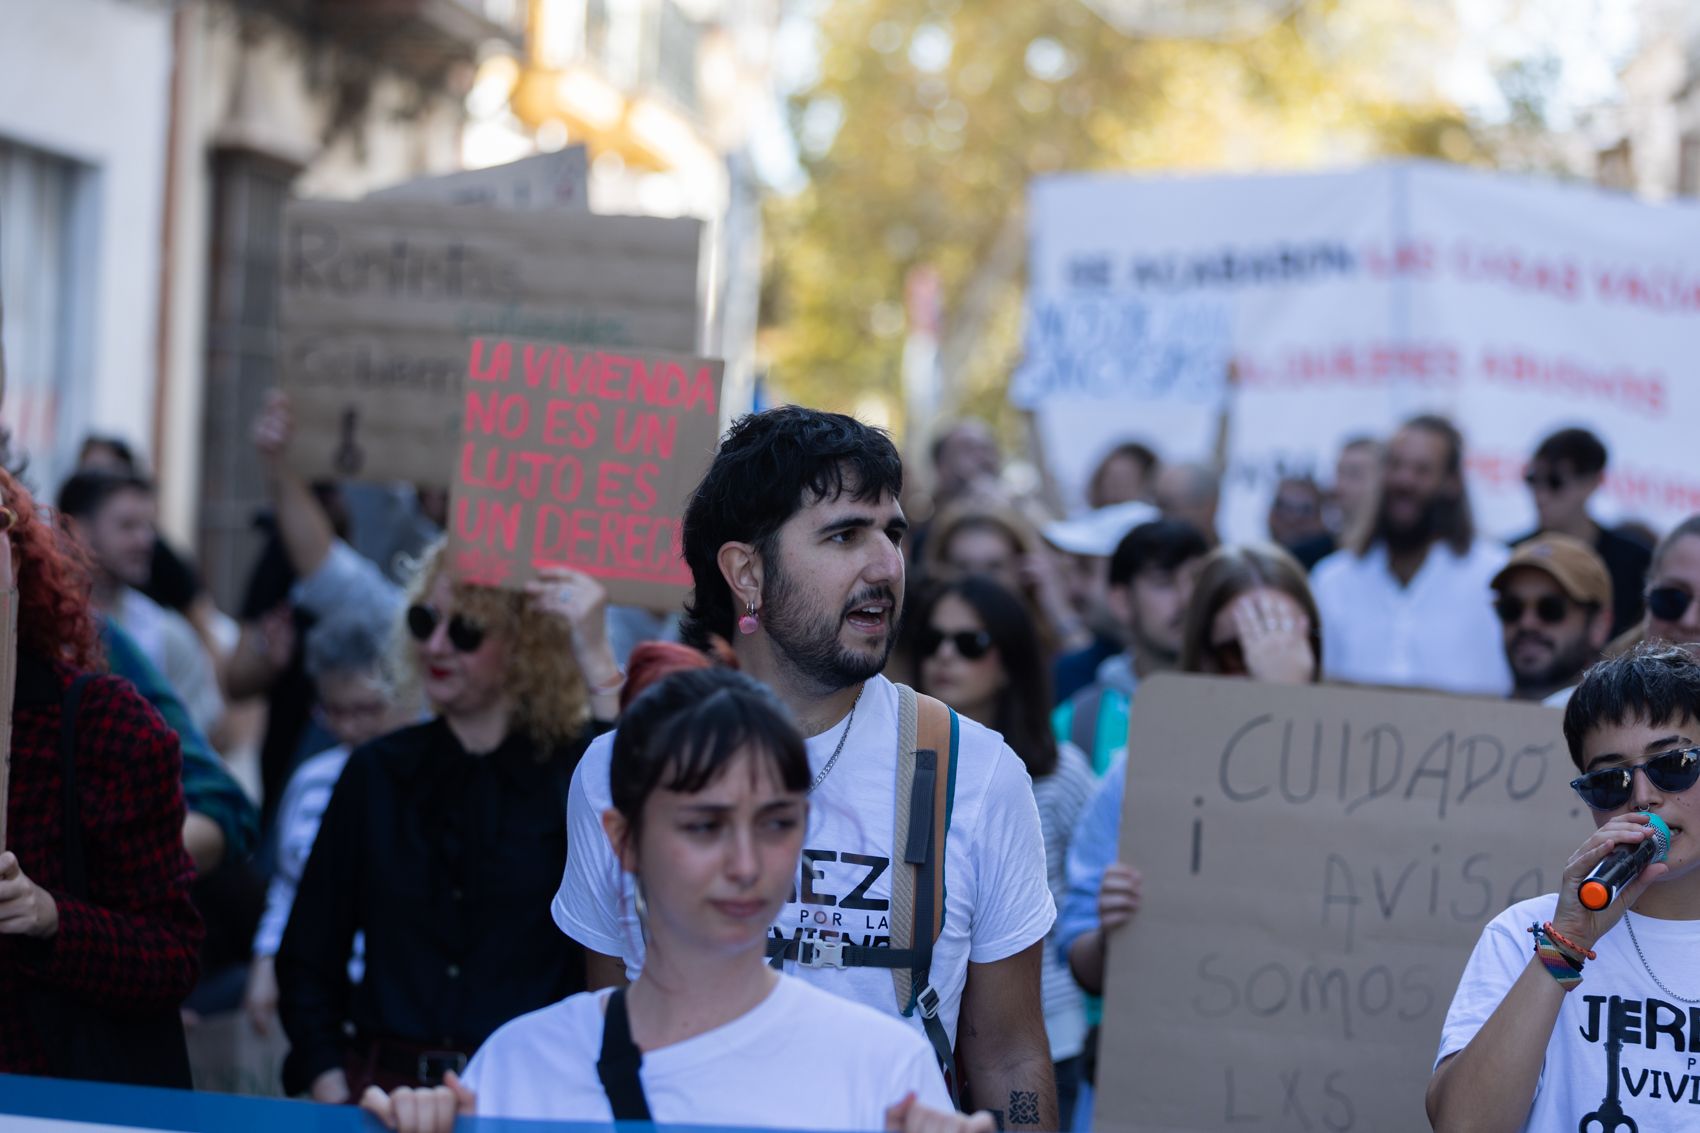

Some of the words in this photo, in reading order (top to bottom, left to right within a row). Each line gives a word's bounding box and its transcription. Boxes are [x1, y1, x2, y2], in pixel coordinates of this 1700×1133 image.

[467, 338, 512, 382] LA
[465, 391, 531, 440] NO
[542, 398, 600, 449] ES
[613, 407, 677, 460] UN
[460, 441, 584, 503] LUJO
[596, 460, 660, 513] ES
[456, 497, 523, 551] UN
[787, 849, 889, 912] EZ
[800, 909, 842, 926] POR
[866, 915, 889, 930] LA
[1195, 953, 1437, 1041] SOMOS
